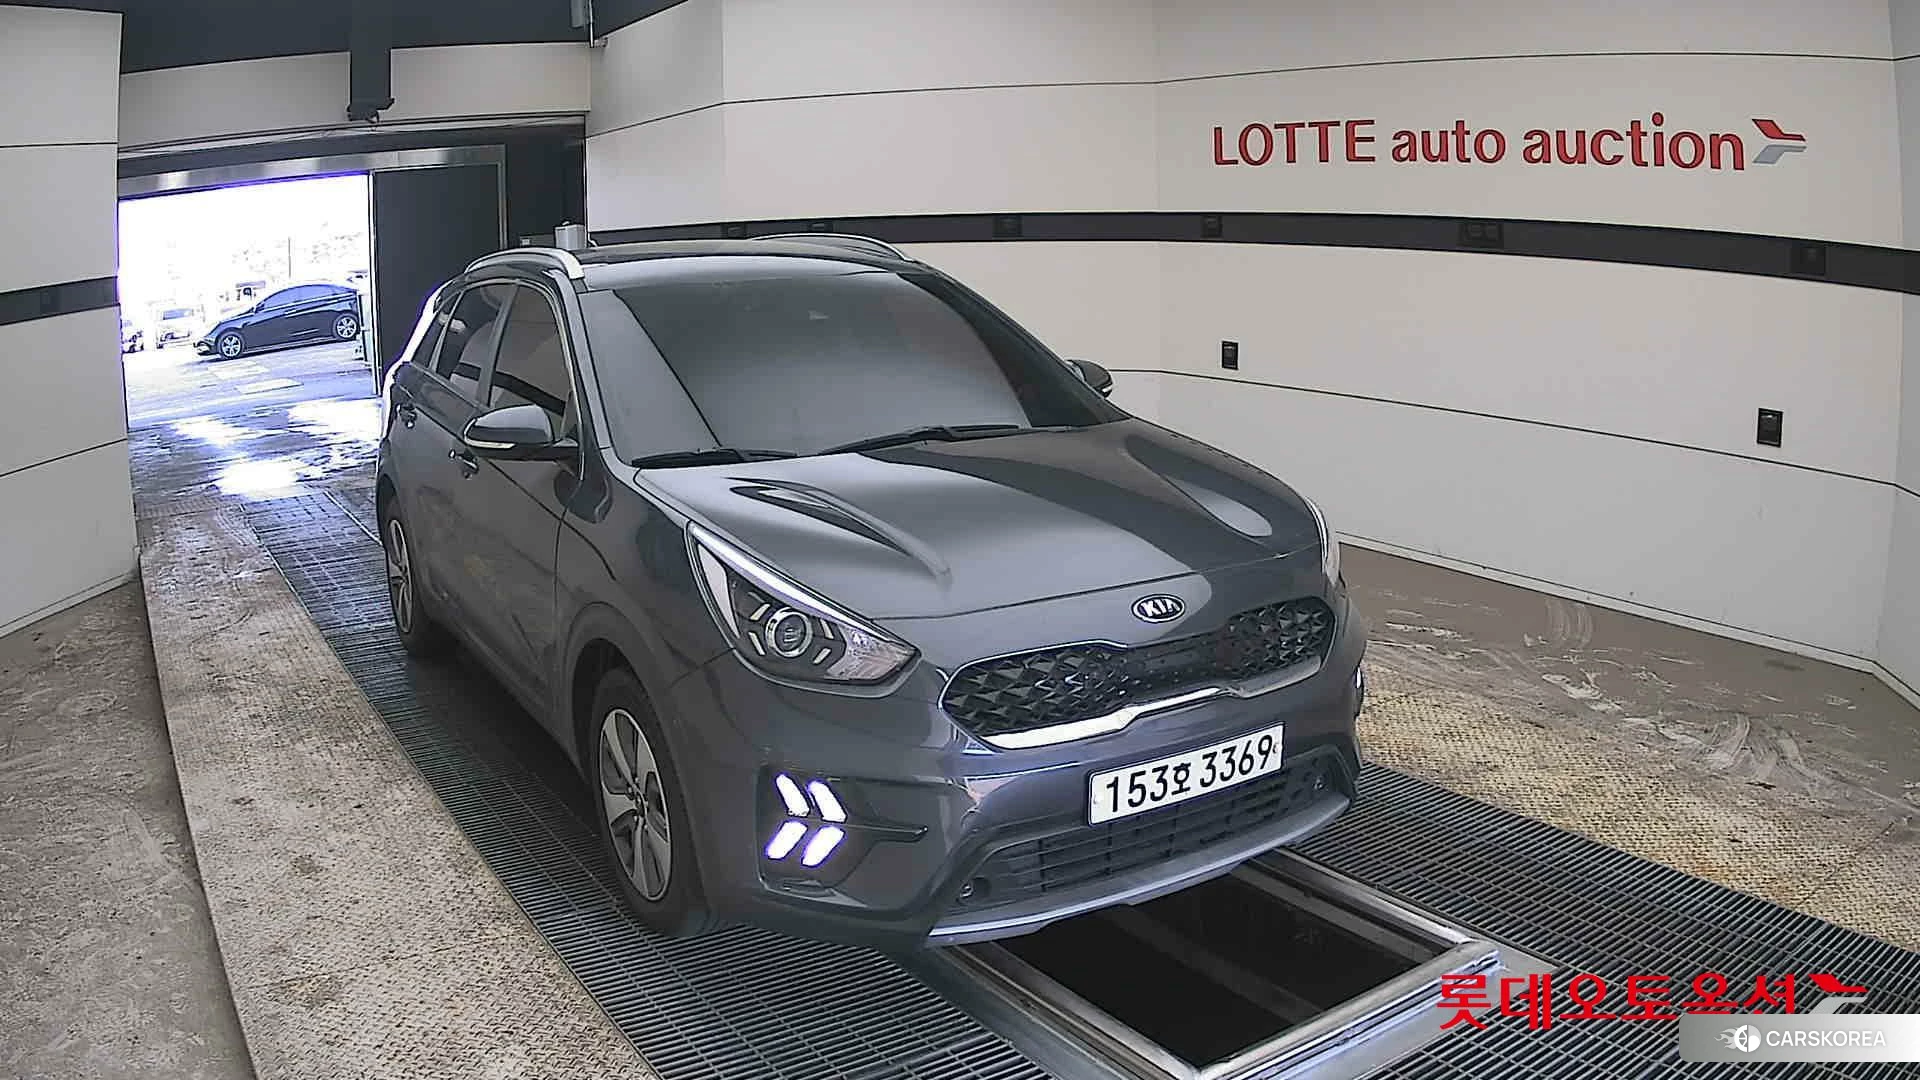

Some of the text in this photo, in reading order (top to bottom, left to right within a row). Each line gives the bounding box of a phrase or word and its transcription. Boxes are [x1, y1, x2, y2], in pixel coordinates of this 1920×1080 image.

[1214, 112, 1746, 172] LOTTE auto auction
[1140, 598, 1181, 617] KIA
[1106, 734, 1273, 813] 153호 3369
